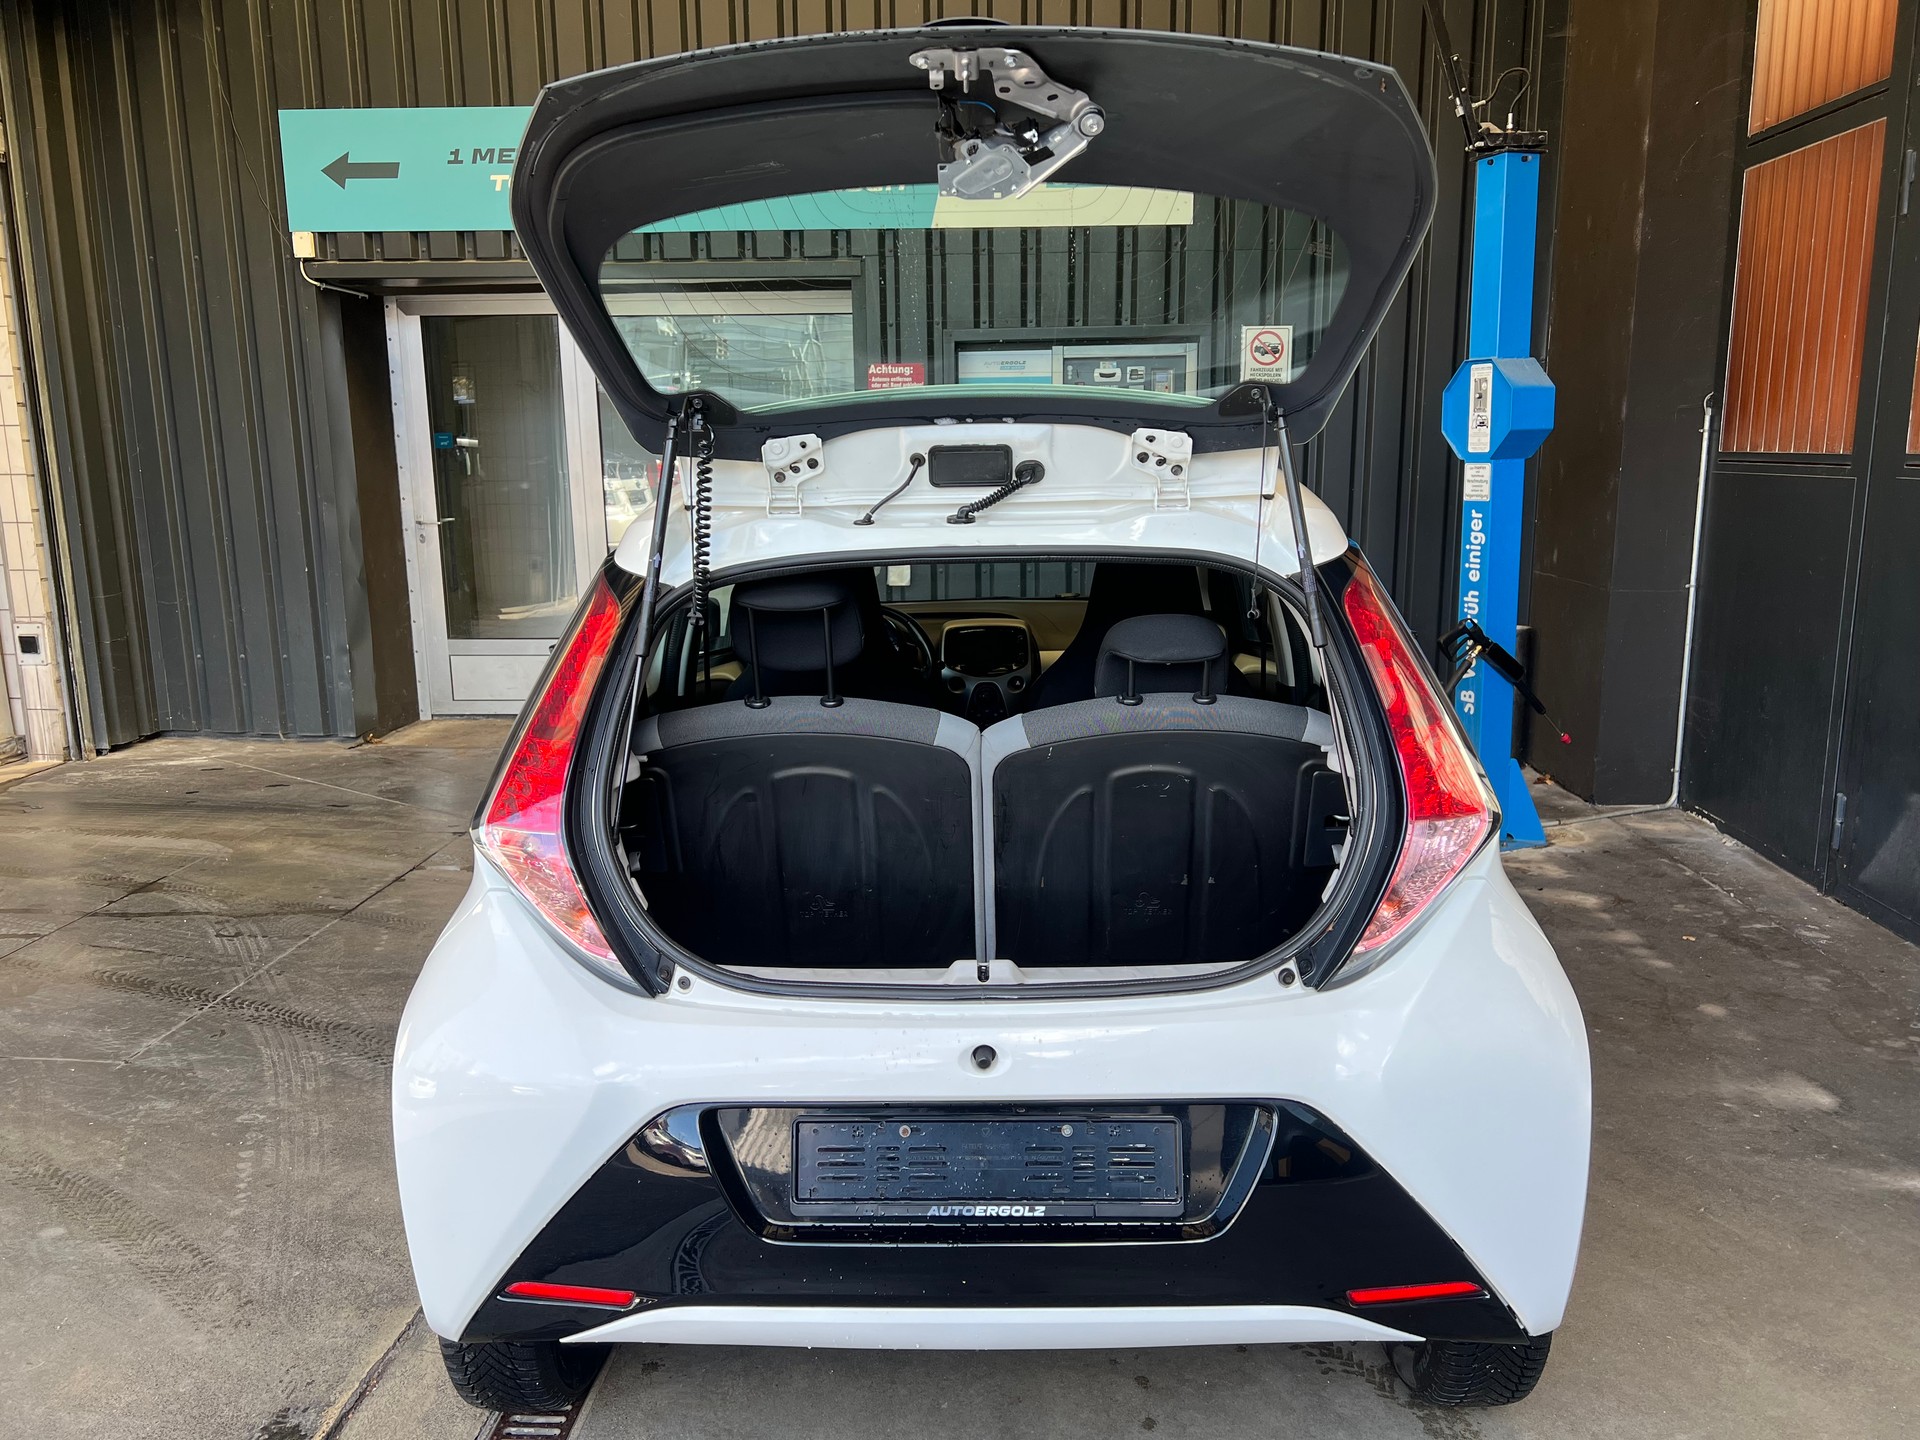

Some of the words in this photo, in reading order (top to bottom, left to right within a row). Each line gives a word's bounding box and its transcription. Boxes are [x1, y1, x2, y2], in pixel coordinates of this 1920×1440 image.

[447, 148, 464, 164] 1
[490, 174, 512, 191] T
[869, 364, 914, 376] Achtung:
[927, 1205, 1046, 1217] AUTOERGOLZ
